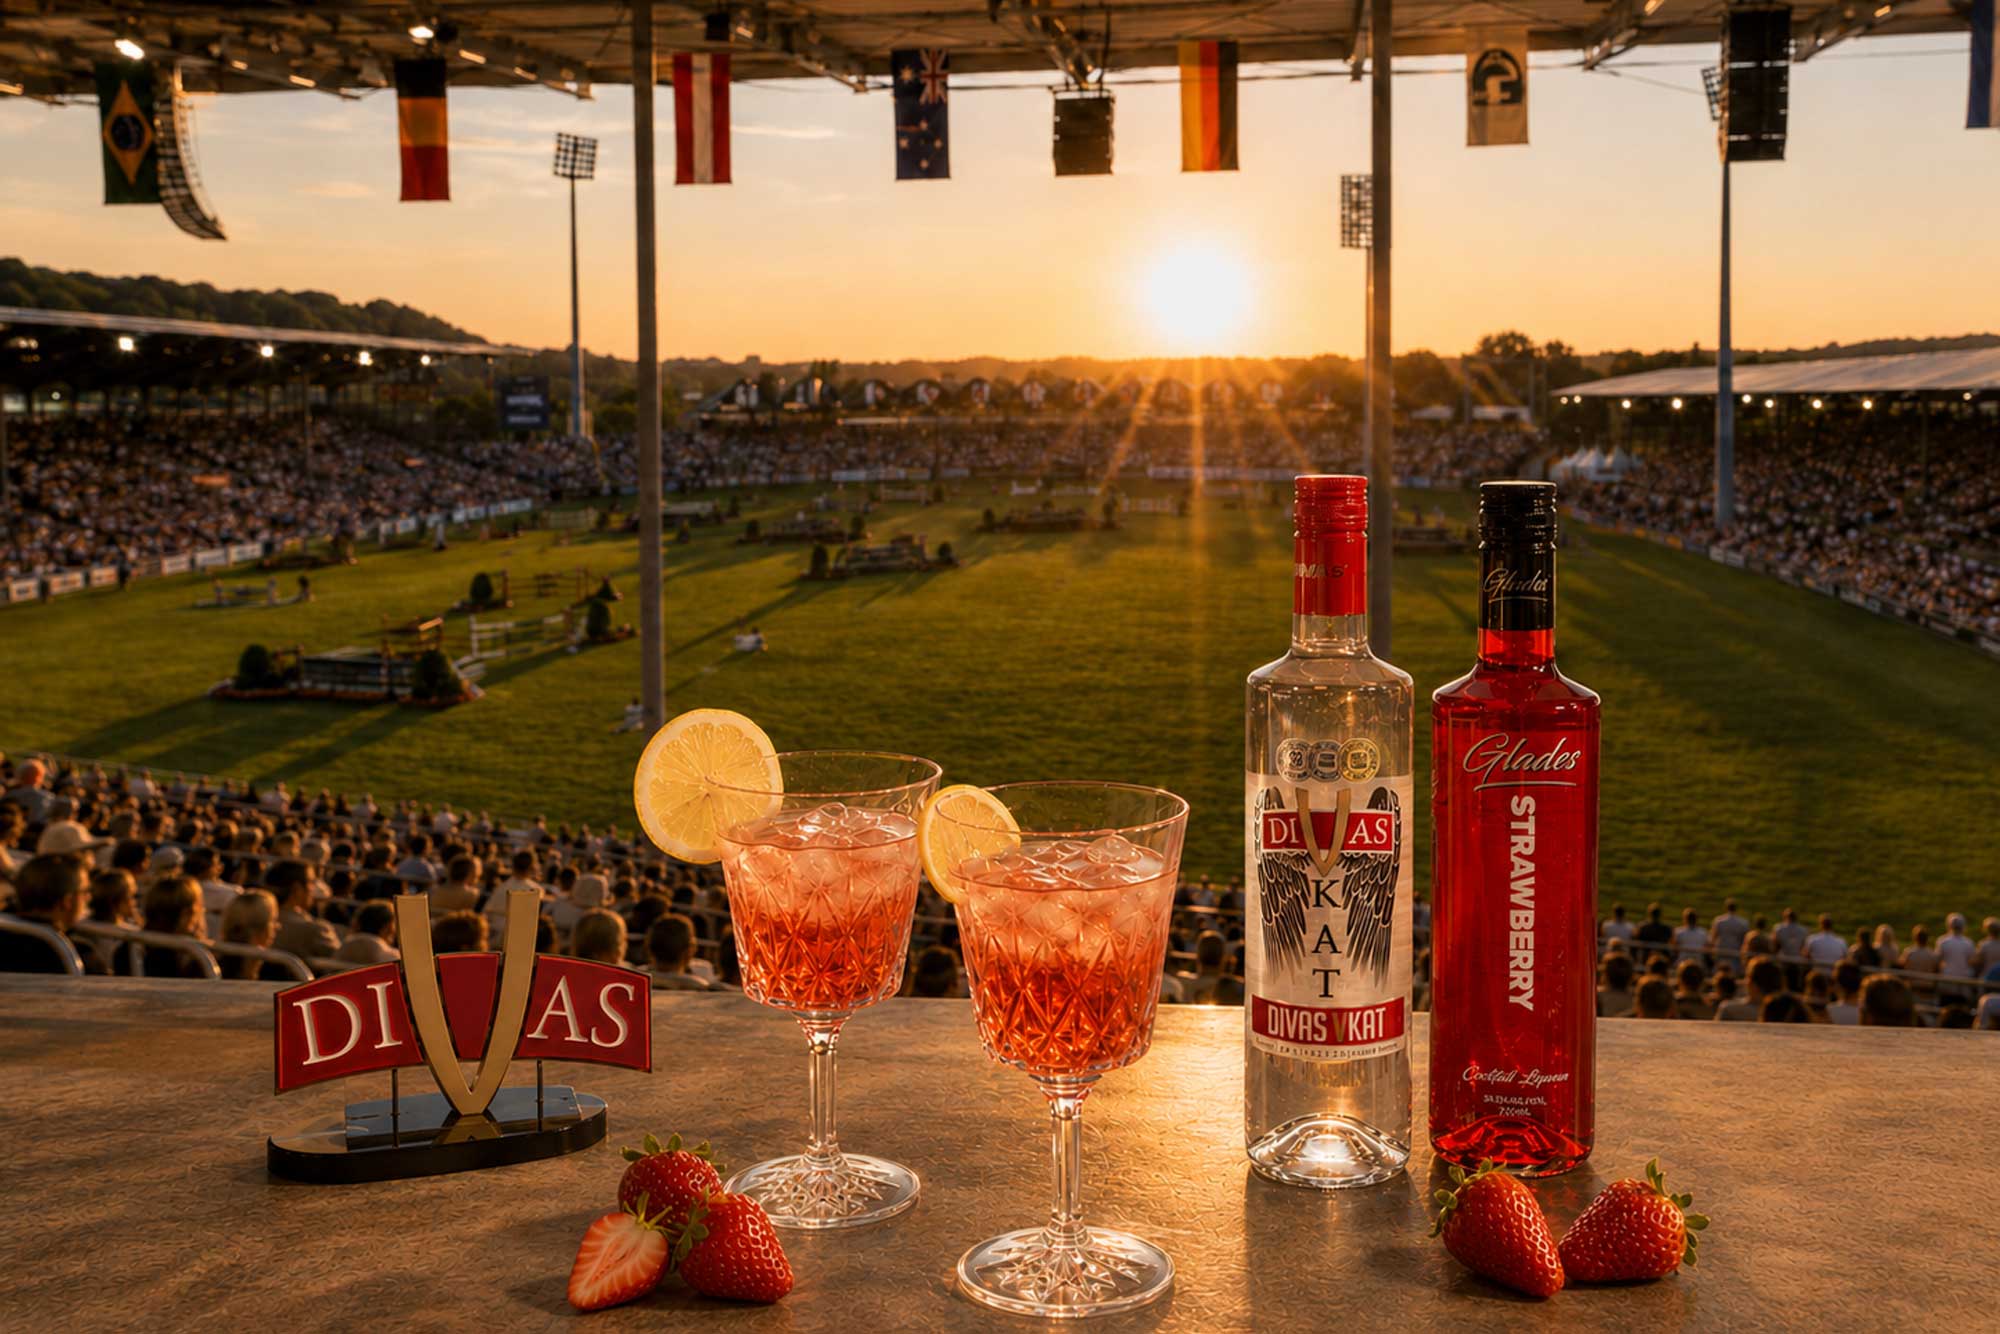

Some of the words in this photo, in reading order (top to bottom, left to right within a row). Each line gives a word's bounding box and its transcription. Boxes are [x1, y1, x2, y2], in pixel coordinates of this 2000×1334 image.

[1463, 733, 1581, 784] Glades
[1268, 788, 1388, 877] DIVAS
[1509, 795, 1536, 1012] STRAWBERRY
[293, 889, 635, 1115] DIVAS
[1268, 1004, 1327, 1042] DIVAS
